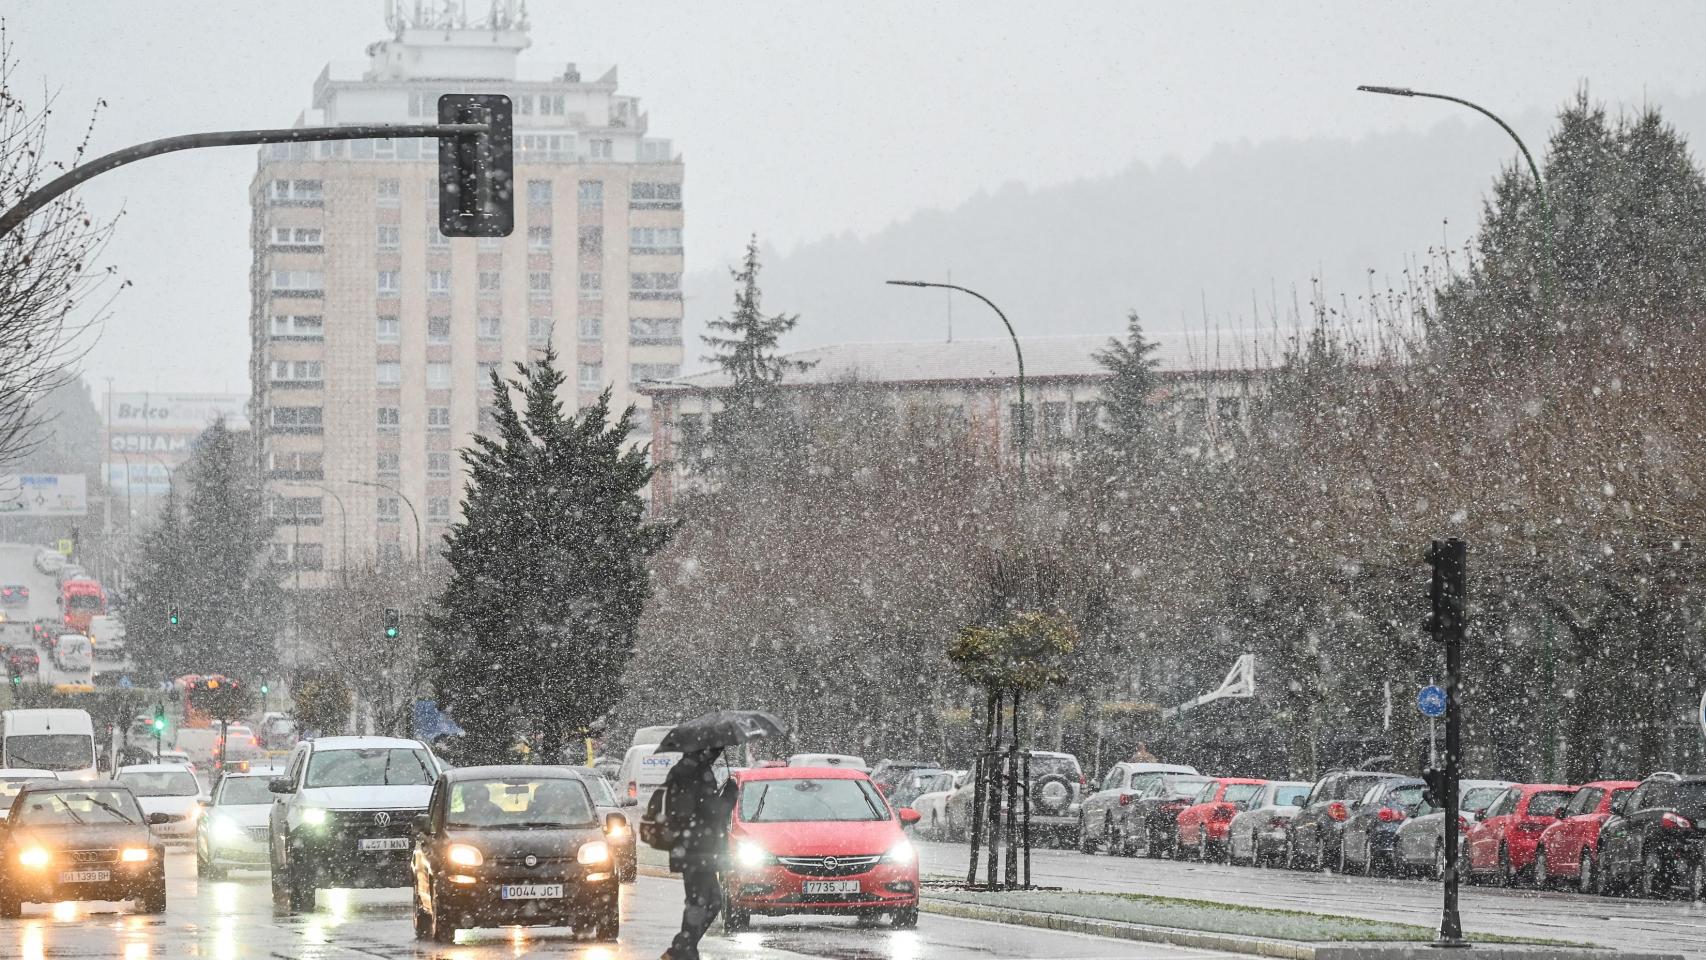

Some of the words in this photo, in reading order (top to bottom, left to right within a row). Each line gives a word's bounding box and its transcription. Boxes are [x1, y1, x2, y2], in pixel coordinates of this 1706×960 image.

[509, 886, 536, 897] 0044
[540, 886, 560, 897] JCT
[809, 882, 836, 893] 7735
[838, 882, 859, 892] JLJ
